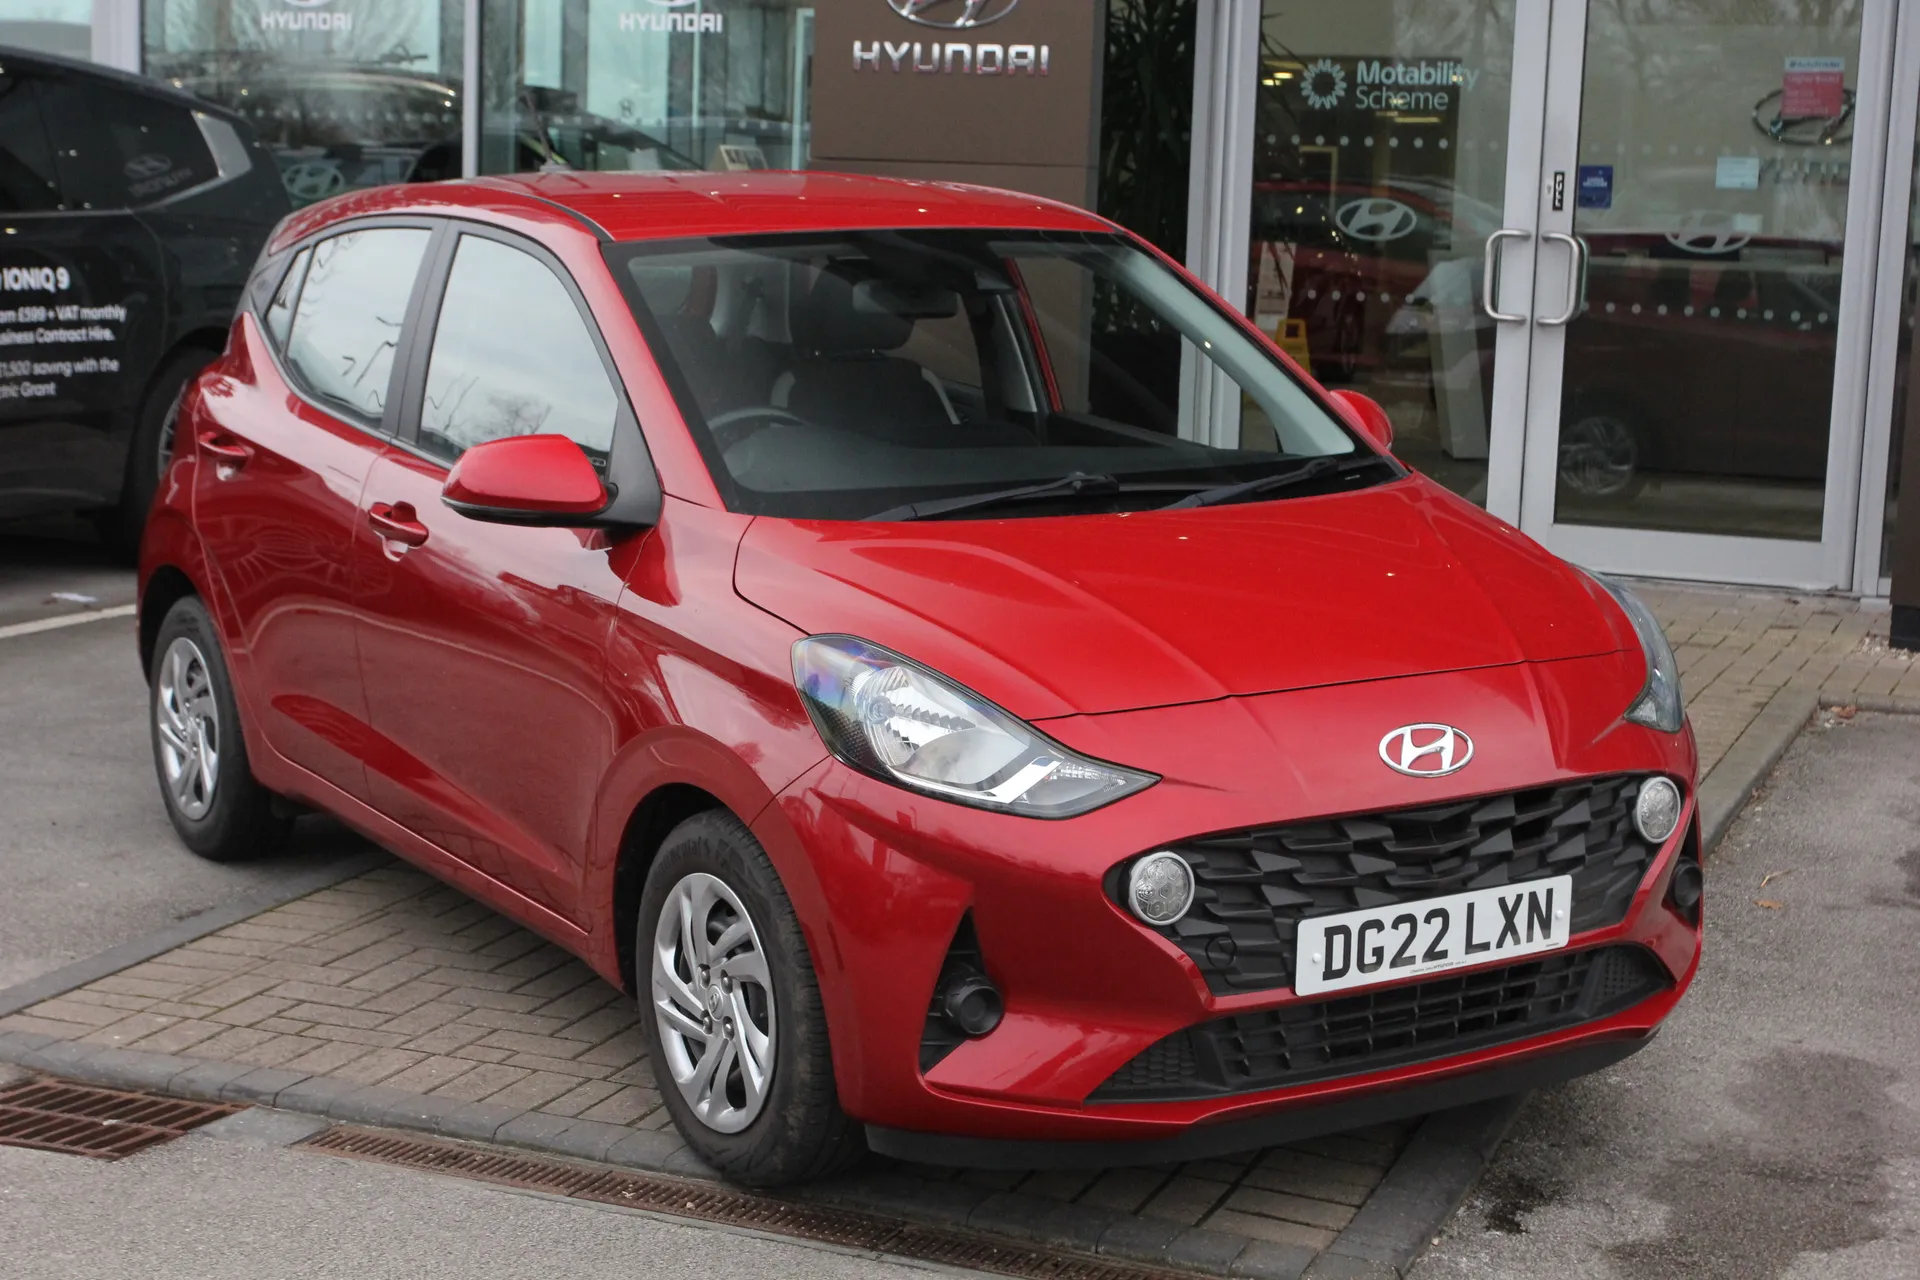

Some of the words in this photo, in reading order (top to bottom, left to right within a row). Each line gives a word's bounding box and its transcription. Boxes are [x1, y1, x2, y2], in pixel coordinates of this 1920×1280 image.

[262, 11, 352, 31] HYUNDAI
[620, 12, 723, 33] HYUNDAI
[852, 40, 1050, 76] HYUNDAI
[1356, 60, 1479, 90] Motability
[1355, 86, 1449, 111] Scheme
[3, 267, 55, 293] IONIQ
[56, 266, 70, 290] 9
[55, 305, 79, 321] VAT
[80, 304, 127, 323] monthly
[36, 327, 87, 343] Contract
[33, 361, 72, 377] saving
[73, 357, 98, 372] with
[99, 357, 119, 372] the
[20, 381, 56, 397] Grant
[1322, 906, 1450, 981] DG22
[1464, 887, 1553, 955] LXN
